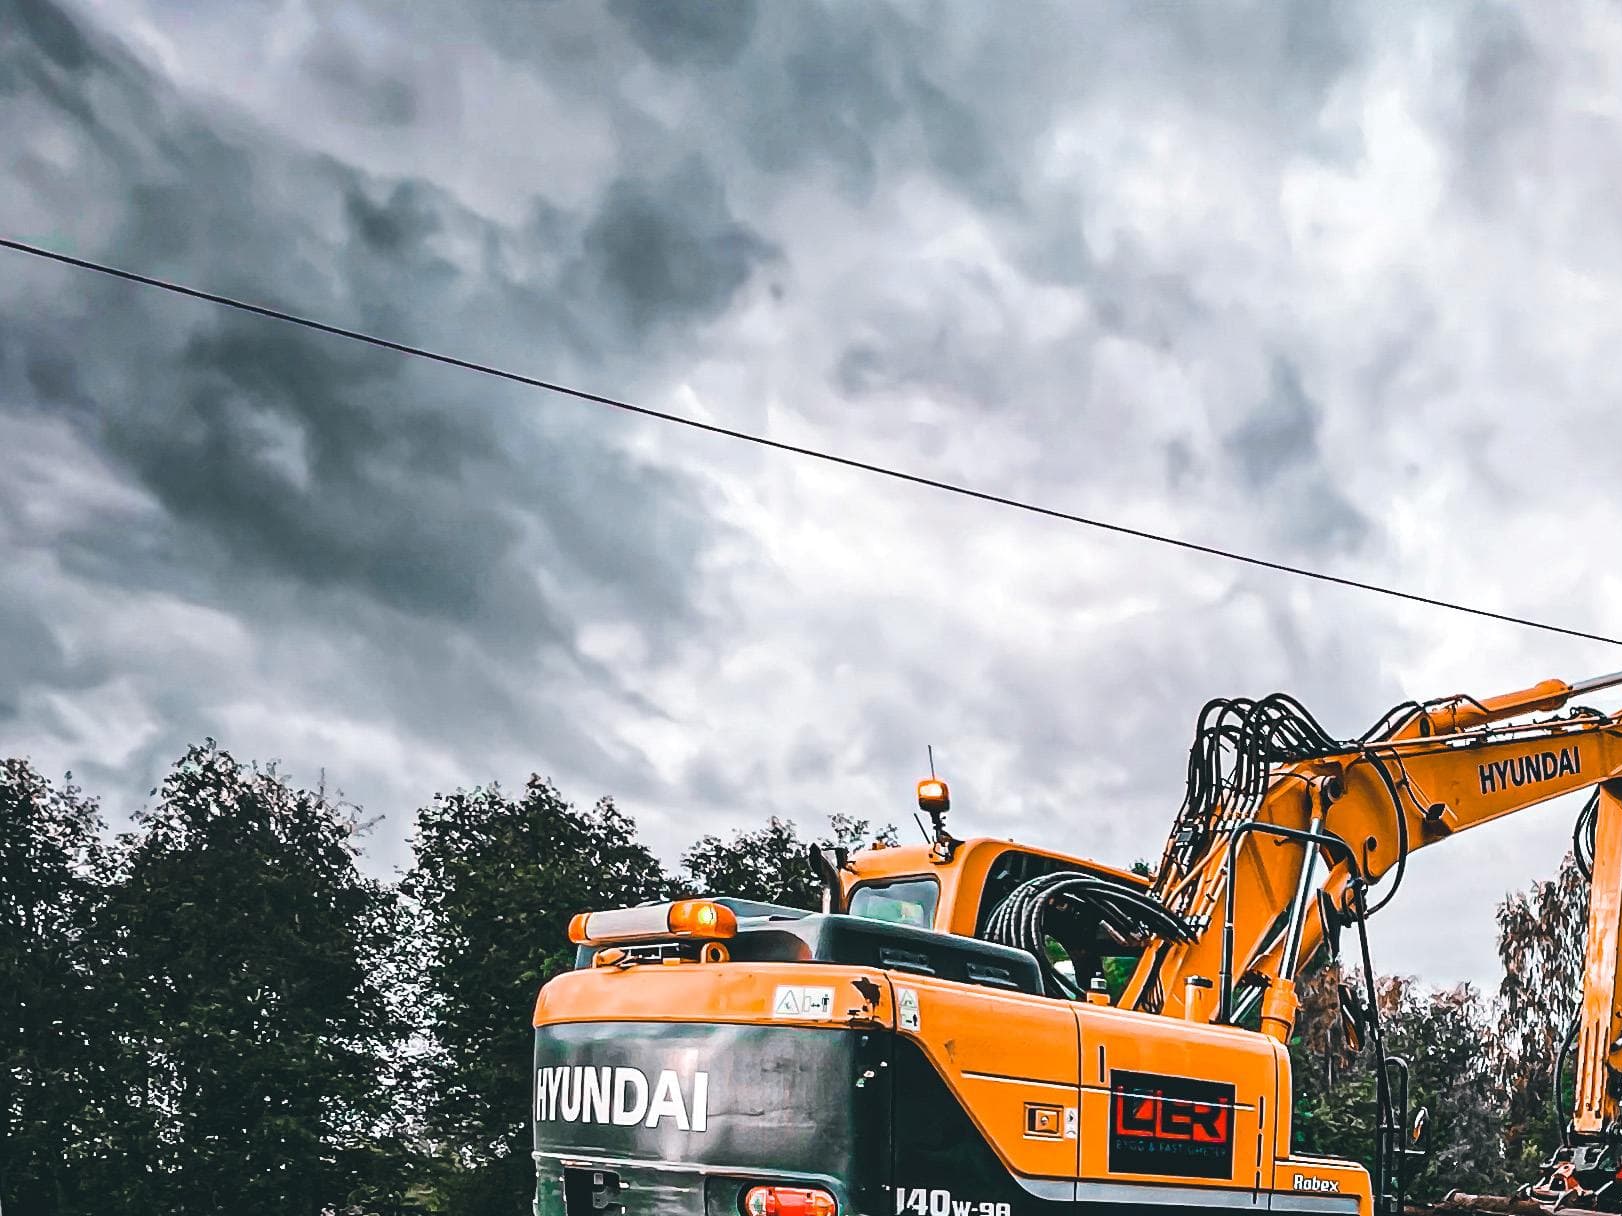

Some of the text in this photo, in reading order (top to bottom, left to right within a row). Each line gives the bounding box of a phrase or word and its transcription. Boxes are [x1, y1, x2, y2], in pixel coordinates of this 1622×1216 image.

[1479, 745, 1581, 795] HYUNDAI
[536, 1066, 708, 1132] HYUNDAI
[1294, 1174, 1339, 1192] Robex
